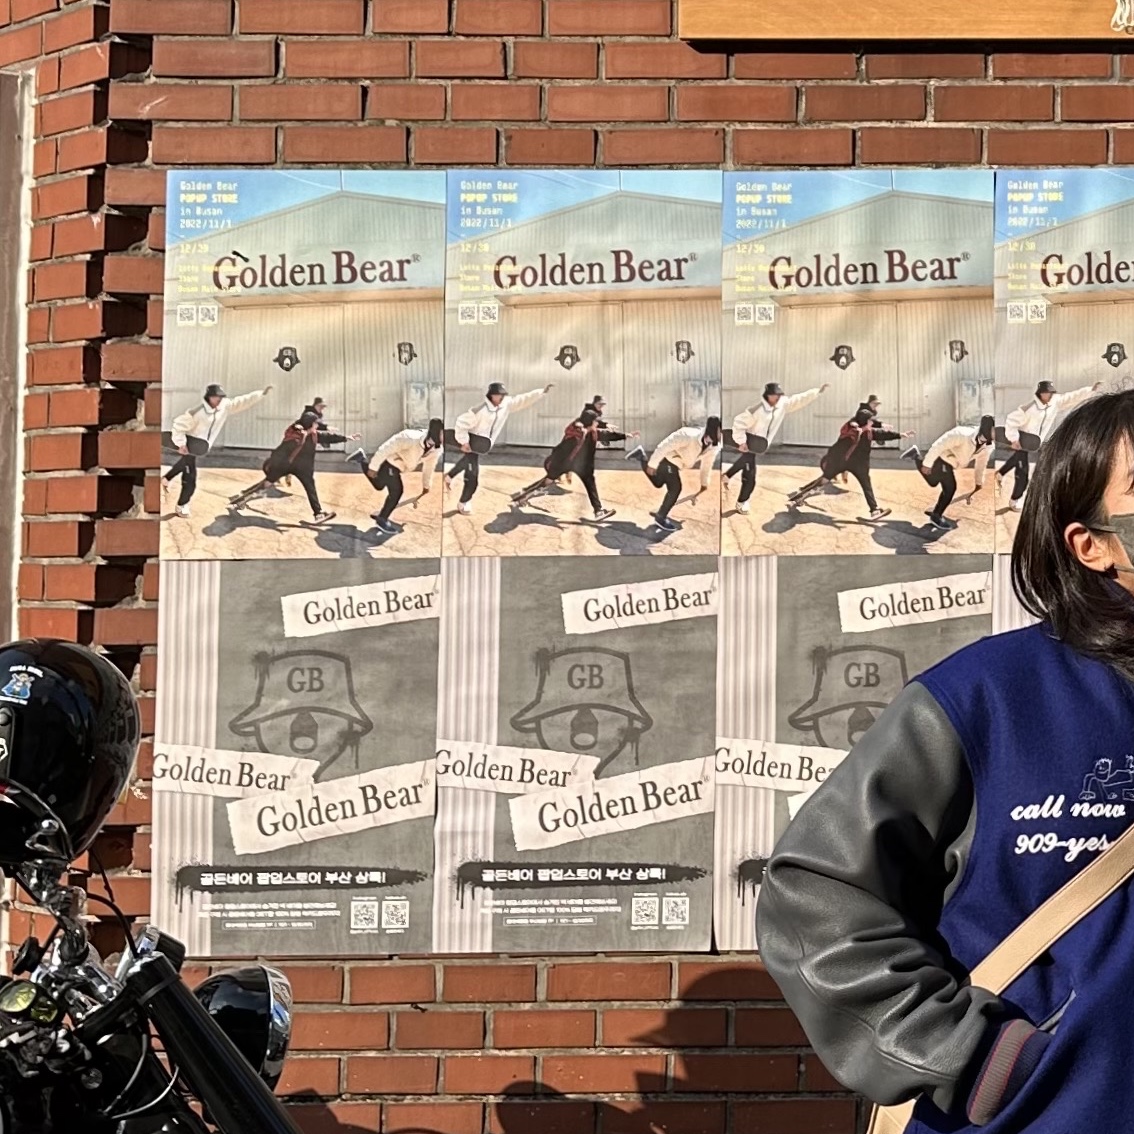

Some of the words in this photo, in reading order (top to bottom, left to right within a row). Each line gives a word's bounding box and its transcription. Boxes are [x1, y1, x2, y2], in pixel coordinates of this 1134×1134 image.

[212, 254, 327, 290] Golden
[493, 253, 606, 289] Golden
[768, 253, 880, 290] Golden
[303, 592, 382, 626] Golden
[583, 589, 661, 622] Golden
[859, 587, 937, 621] Golden
[286, 666, 325, 693] GB
[567, 663, 605, 690] GB
[843, 661, 881, 689] GB
[151, 753, 232, 787] Golden
[435, 749, 515, 783] Golden
[714, 747, 793, 781] Golden
[796, 756, 836, 782] Be
[256, 798, 359, 837] Golden
[537, 795, 639, 834] Golden
[1010, 795, 1065, 820] call
[1070, 802, 1125, 818] now
[200, 872, 253, 886] 골든베어
[257, 871, 321, 885] 팝업스토어
[325, 872, 352, 884] 부산
[481, 869, 533, 882] 골든베어
[537, 869, 602, 881] 팝업스토어
[605, 868, 632, 880] 부산
